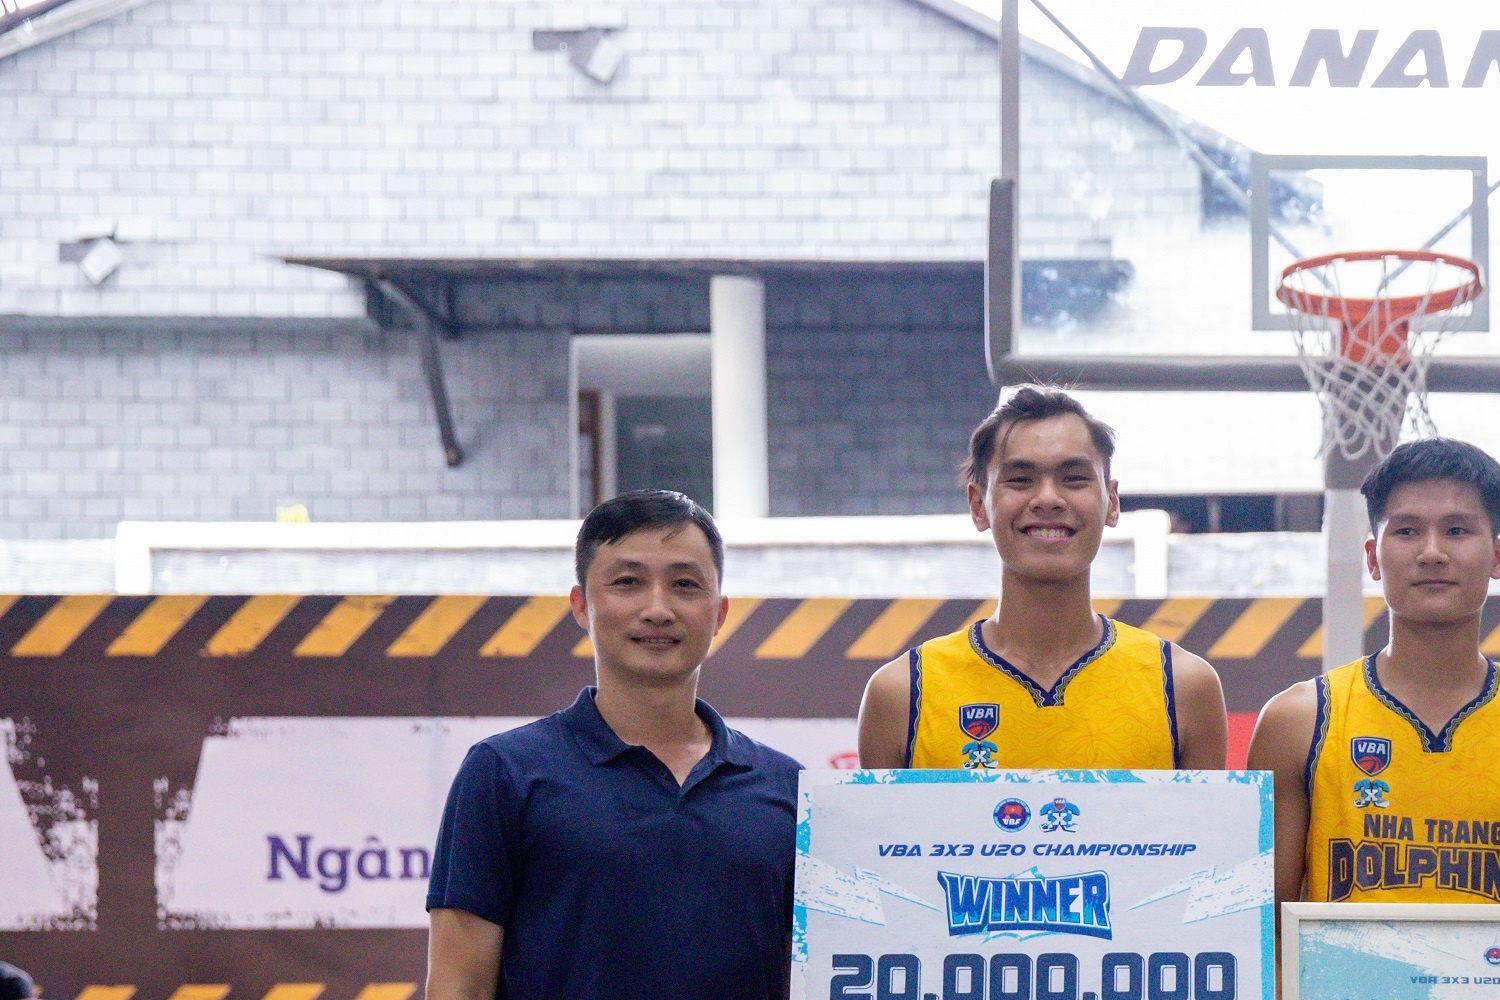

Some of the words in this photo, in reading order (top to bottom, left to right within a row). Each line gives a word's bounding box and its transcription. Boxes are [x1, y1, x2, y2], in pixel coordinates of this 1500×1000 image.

[966, 707, 995, 719] VBA
[1357, 741, 1387, 755] VBA
[1364, 814, 1414, 841] NHA
[878, 843, 922, 857] VBA
[929, 843, 974, 857] 3X3
[981, 843, 1026, 857] U20
[1033, 843, 1197, 857] CHAMPIONSHIP
[266, 834, 430, 893] Ngân
[938, 869, 1112, 940] WINNER
[1410, 976, 1438, 984] VBA
[1442, 976, 1470, 984] 3X3
[1474, 977, 1500, 985] U20
